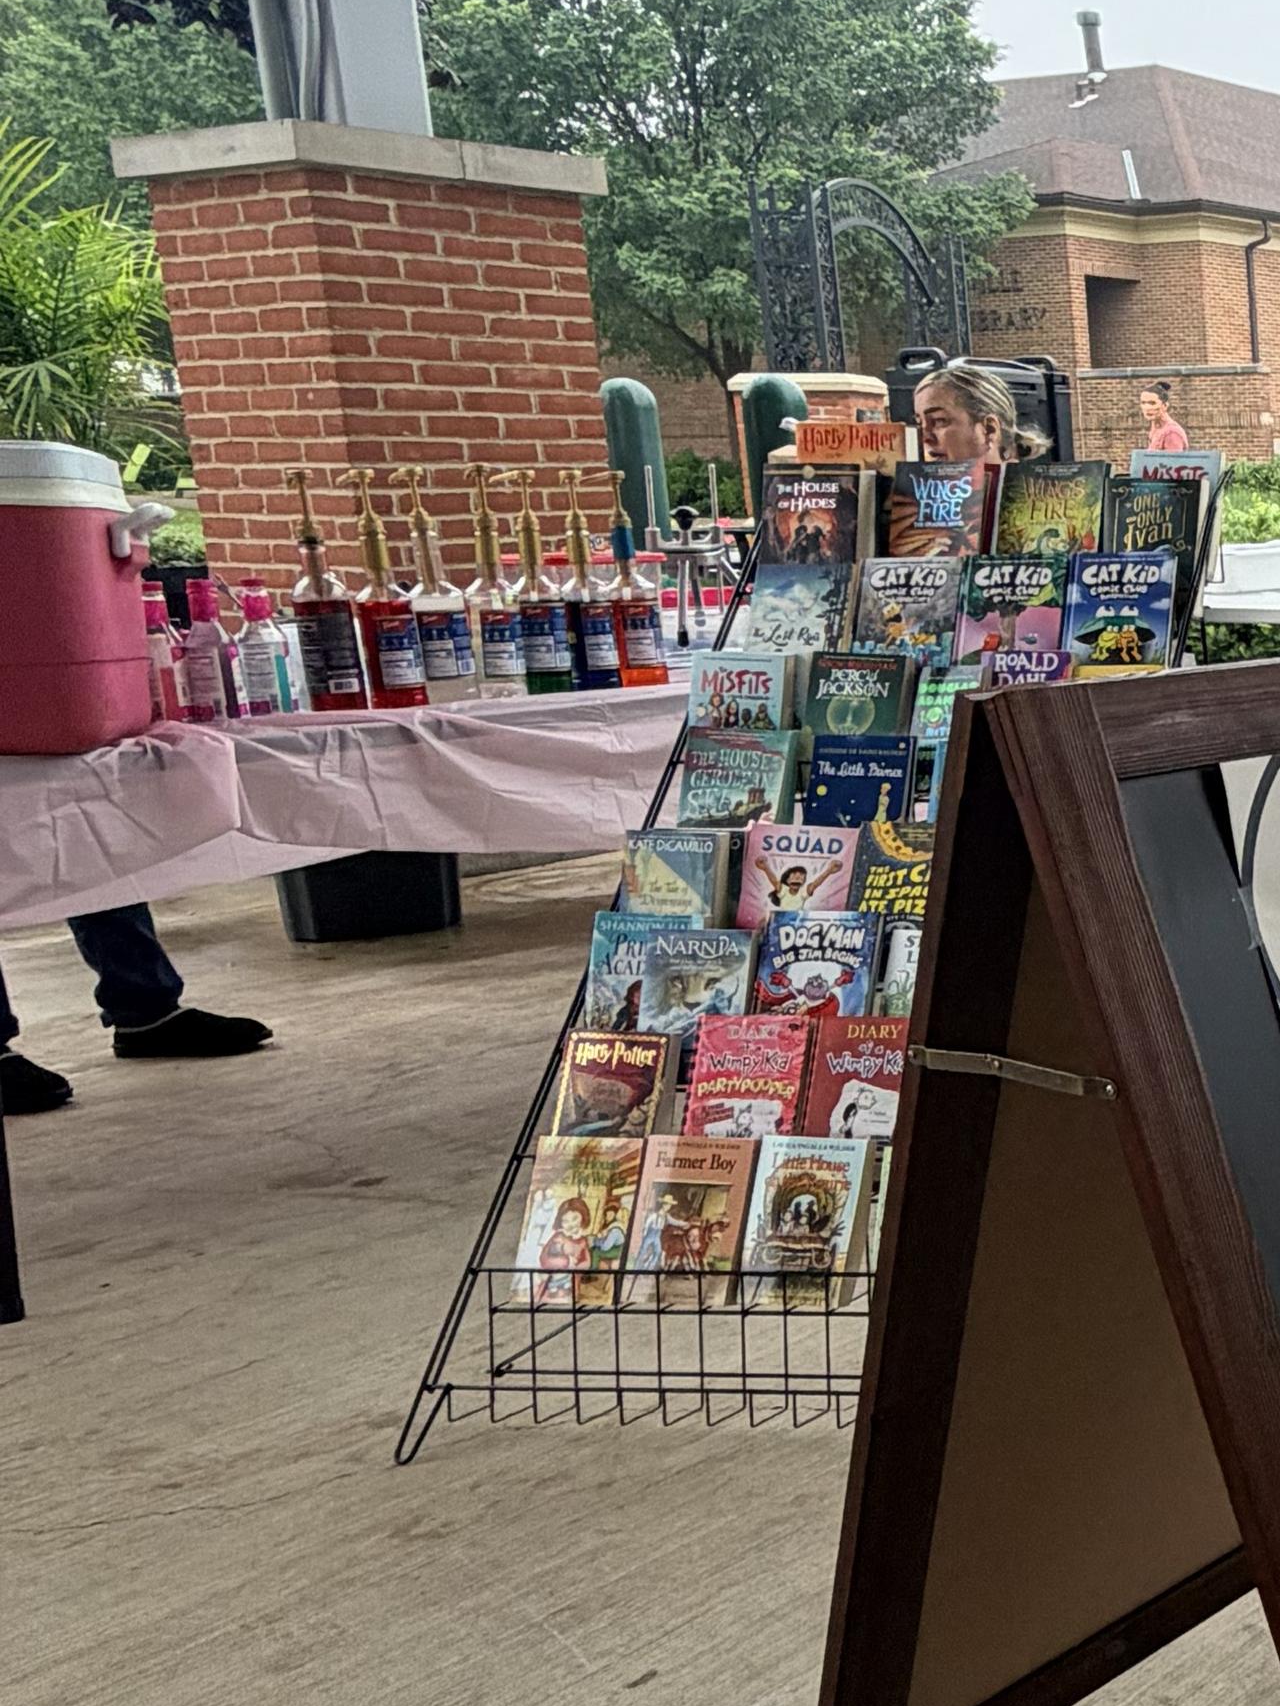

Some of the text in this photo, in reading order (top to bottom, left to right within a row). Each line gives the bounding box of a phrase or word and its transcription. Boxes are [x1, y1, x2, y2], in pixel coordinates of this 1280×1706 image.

[803, 419, 899, 454] Harry Potter
[776, 481, 840, 497] THE HOUSE
[910, 474, 972, 501] WINGS
[1023, 475, 1086, 500] WINGS
[790, 497, 837, 512] HADES
[917, 498, 963, 522] FIRE
[1030, 498, 1075, 521] FIRE
[1133, 493, 1160, 512] ONE
[1137, 505, 1173, 528] ONLY
[870, 568, 910, 589] CAT
[974, 567, 1014, 587] CAT
[1082, 567, 1120, 586] CAT
[994, 652, 1059, 673] ROALD
[830, 669, 879, 681] PERCY
[815, 678, 891, 698] JACKSON
[690, 748, 771, 771] THE HOUSE
[816, 760, 836, 776] The
[627, 838, 654, 851] KATE
[762, 834, 844, 855] SQUAD
[865, 870, 907, 887] FIRST
[857, 899, 889, 914] ATE
[653, 935, 741, 958] NARNIA
[778, 925, 865, 949] DOG MAN
[772, 948, 863, 967] BIG JIM BEGINS
[846, 1024, 902, 1040] DIARY
[574, 1041, 658, 1070] Harry Potter
[708, 1050, 793, 1074] Wimpy Kid
[827, 1052, 882, 1077] Wimpy
[655, 1152, 738, 1174] Farmer Boy
